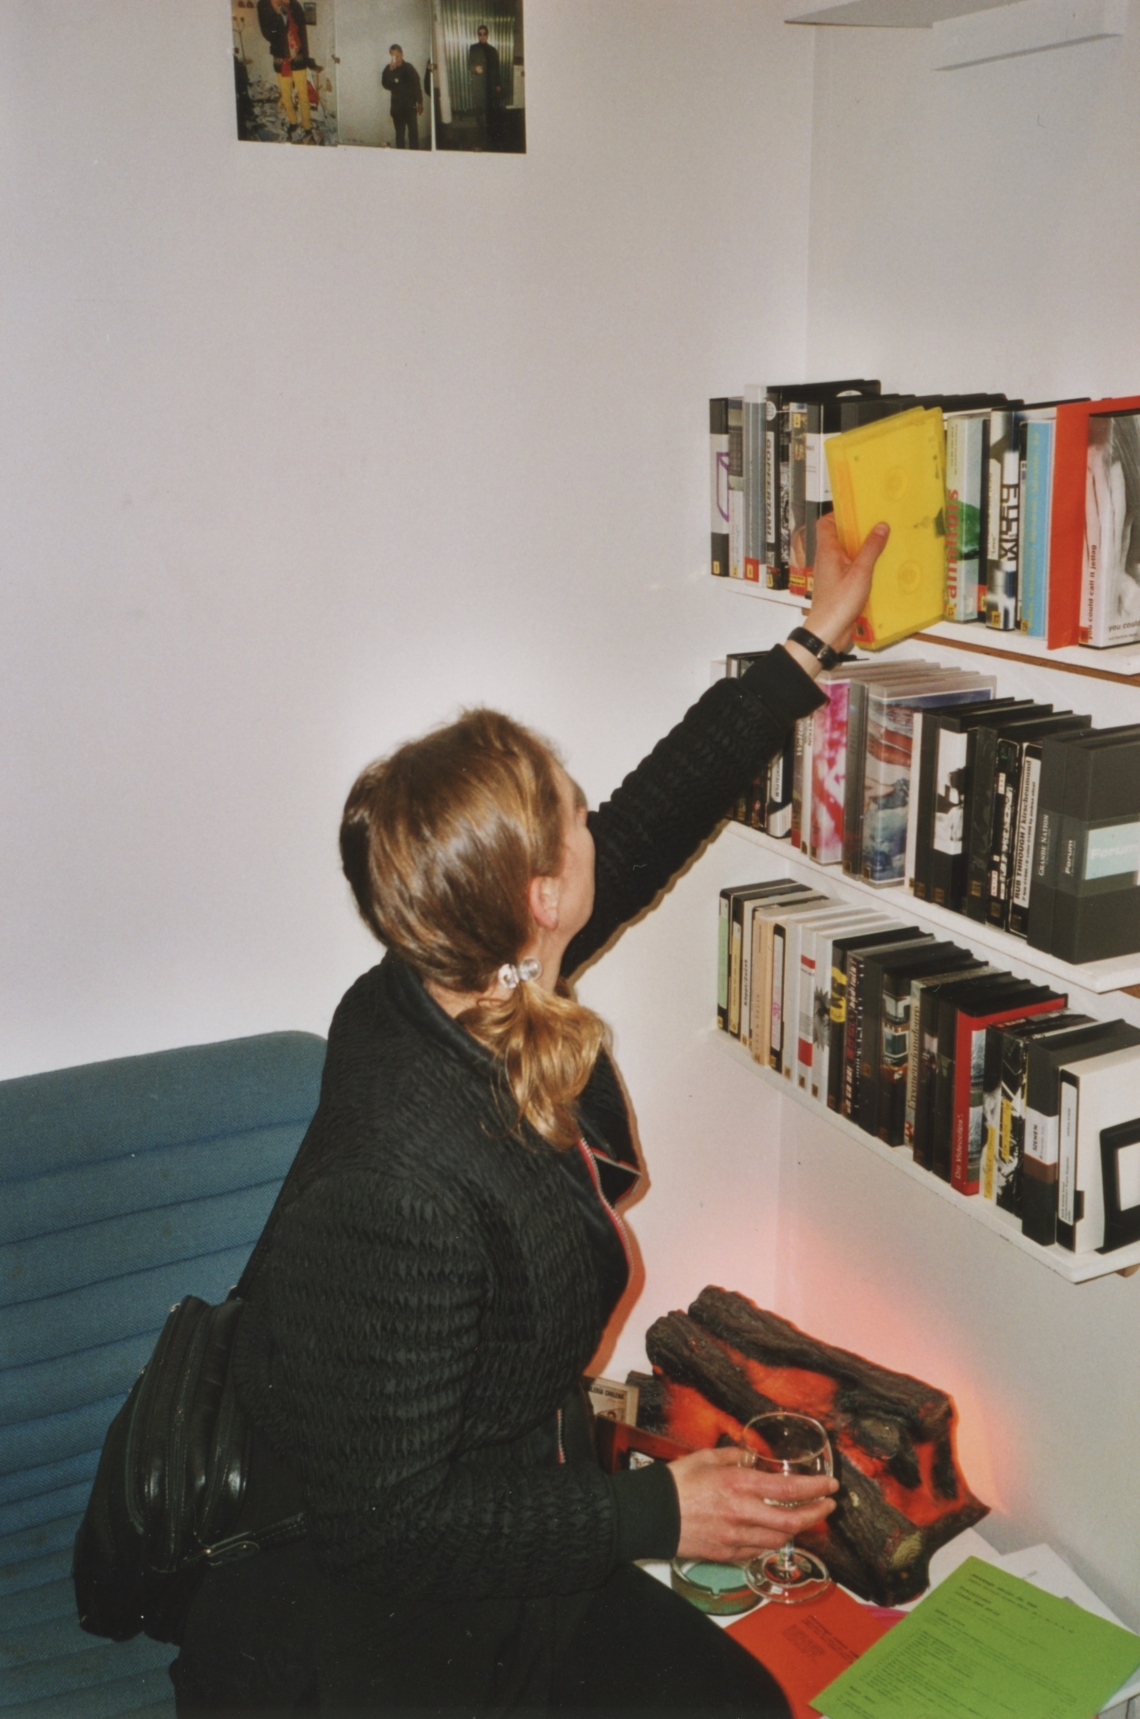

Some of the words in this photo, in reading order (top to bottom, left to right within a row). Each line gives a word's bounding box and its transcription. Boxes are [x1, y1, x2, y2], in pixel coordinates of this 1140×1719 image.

[944, 489, 958, 612] annhois
[1108, 625, 1121, 633] you
[1041, 814, 1049, 843] NATION
[1017, 832, 1025, 876] THROUGH
[1038, 846, 1046, 876] GRANDE
[1065, 840, 1073, 874] Forum
